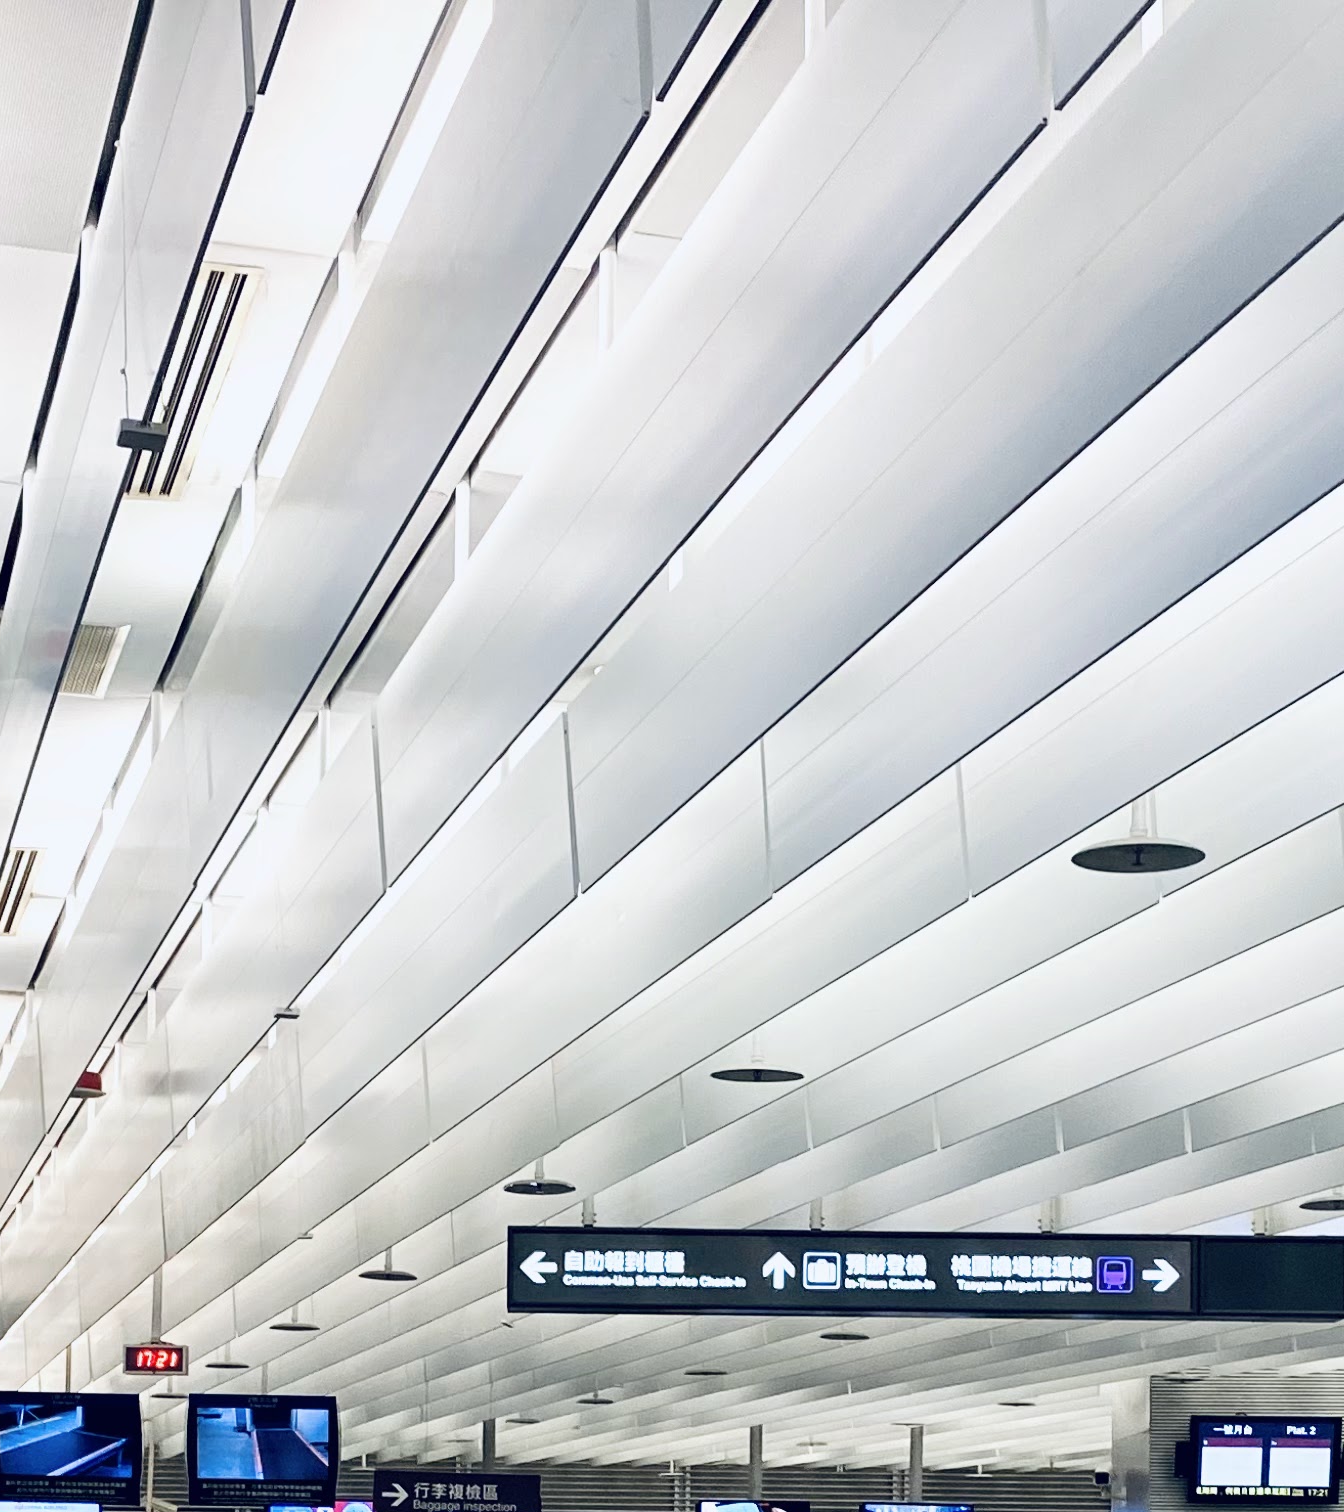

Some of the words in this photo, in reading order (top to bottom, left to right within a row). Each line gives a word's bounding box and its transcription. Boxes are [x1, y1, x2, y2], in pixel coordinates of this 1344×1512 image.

[1309, 1426, 1317, 1435] 2
[414, 1482, 498, 1500] 行李複檢區
[413, 1500, 460, 1512] Baggage
